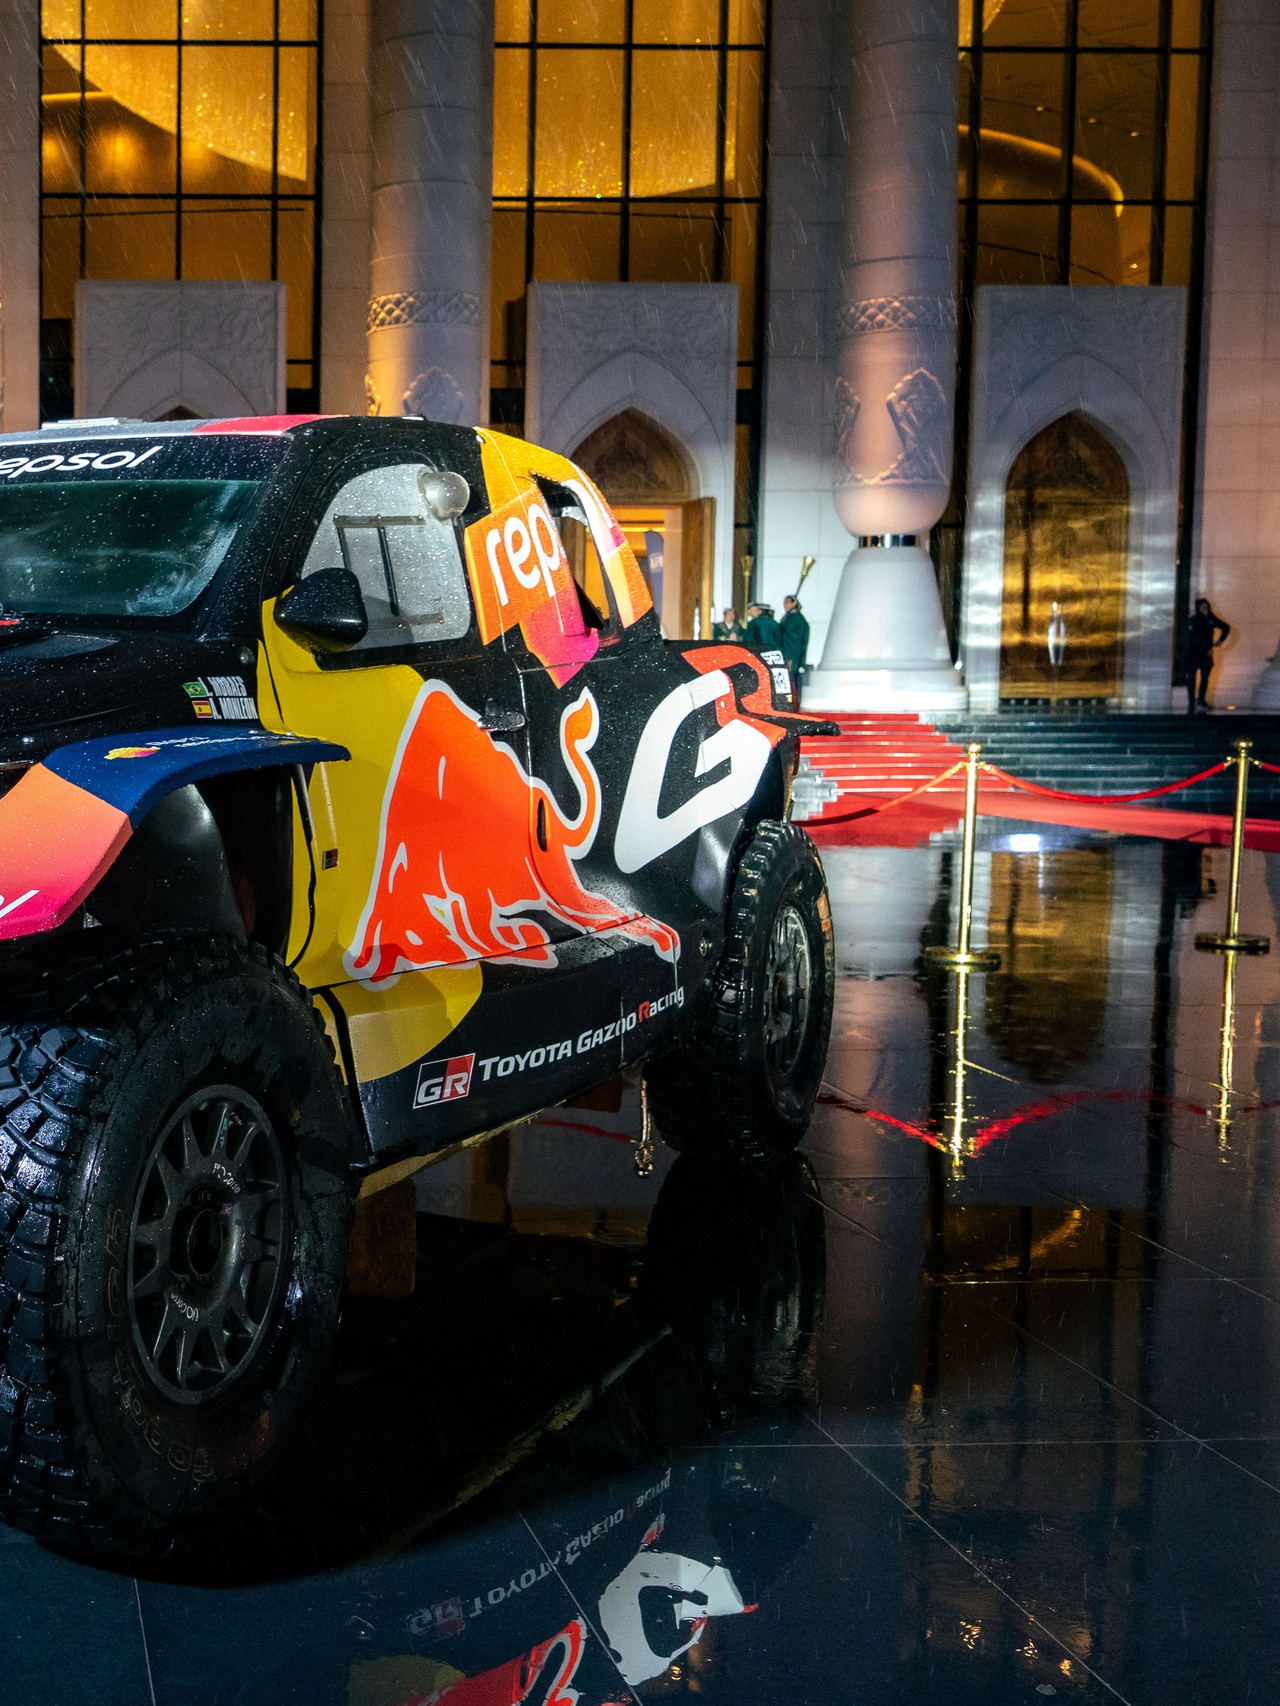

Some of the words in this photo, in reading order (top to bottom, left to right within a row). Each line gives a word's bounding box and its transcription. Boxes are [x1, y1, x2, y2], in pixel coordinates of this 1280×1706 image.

[417, 1071, 469, 1103] GR
[478, 1039, 572, 1081] TOYOTA
[576, 1011, 637, 1054] GAZOO
[637, 985, 684, 1022] Racing
